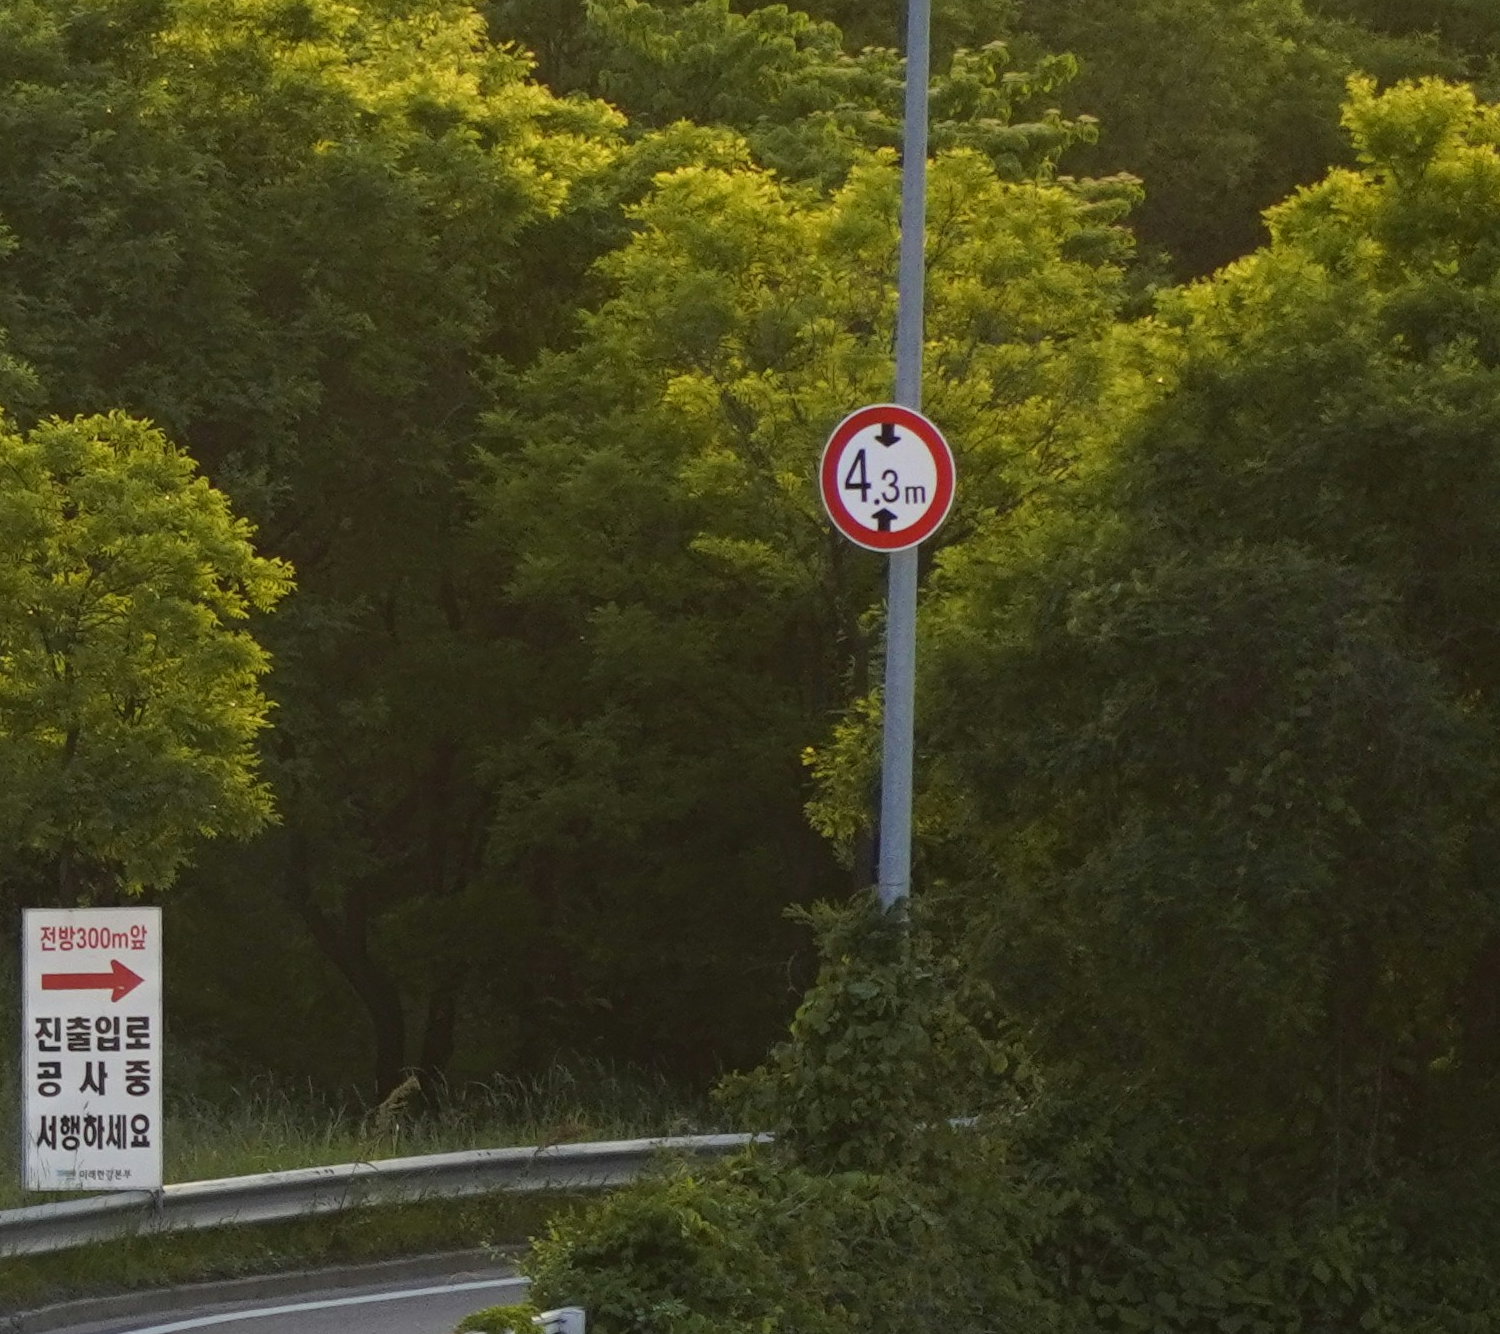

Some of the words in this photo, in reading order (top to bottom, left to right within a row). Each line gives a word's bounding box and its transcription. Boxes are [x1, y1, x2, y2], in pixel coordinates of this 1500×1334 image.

[40, 925, 147, 952] 전방300m앞
[35, 1017, 150, 1052] 진출입로
[37, 1114, 150, 1151] 서행하세요
